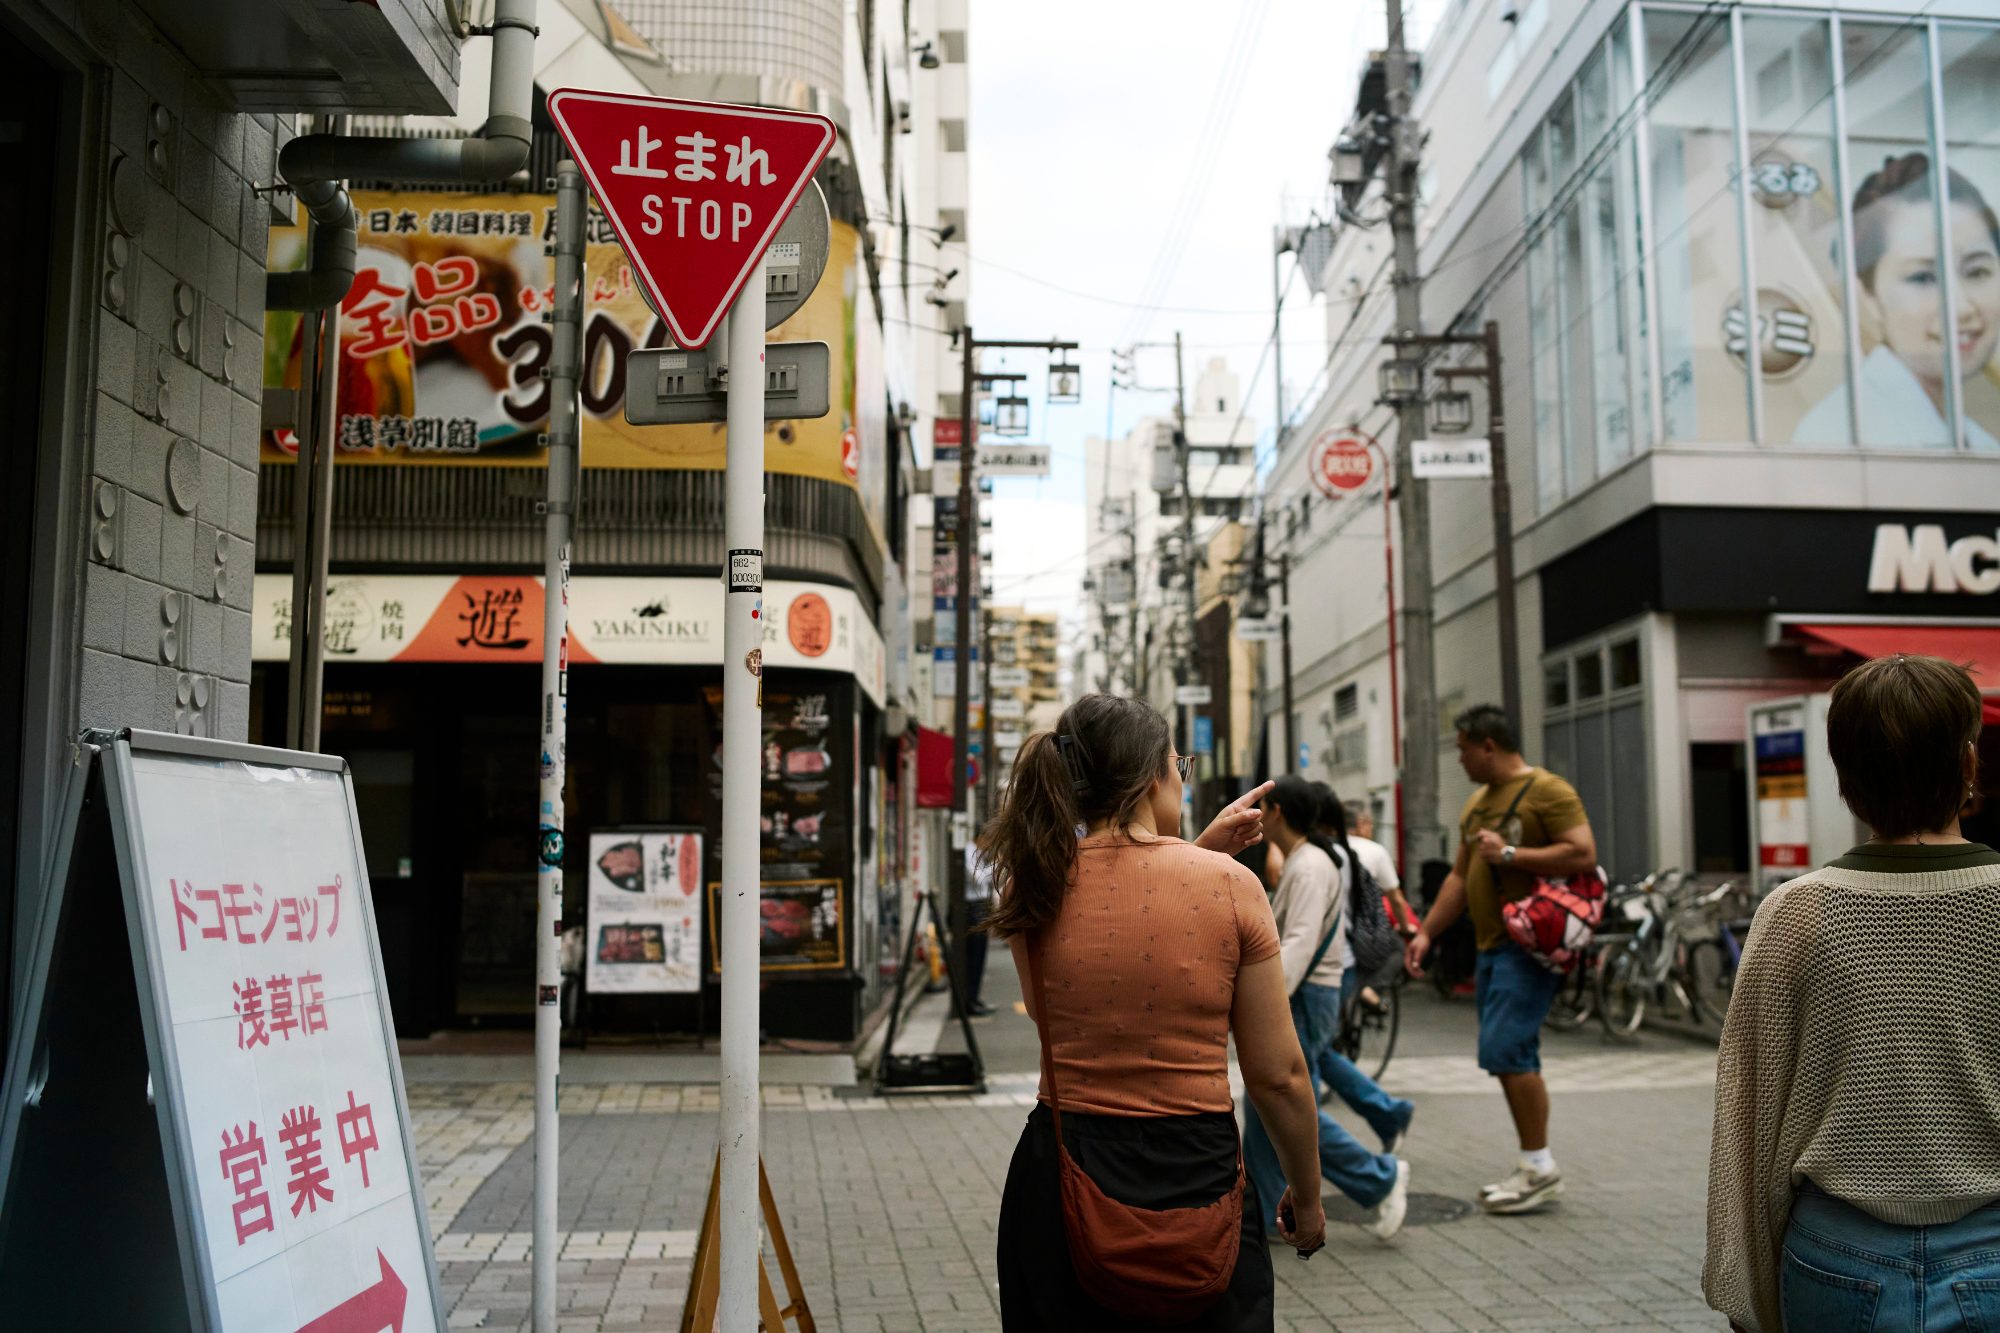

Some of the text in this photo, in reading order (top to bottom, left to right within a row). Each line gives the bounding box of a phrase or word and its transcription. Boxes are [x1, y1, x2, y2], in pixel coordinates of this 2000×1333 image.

[611, 125, 778, 187] 止まれ
[641, 194, 752, 243] STOP
[343, 257, 500, 357] 全品
[342, 415, 478, 449] 浅草別館
[1868, 523, 2000, 595] Mc
[456, 586, 532, 649] 遊
[592, 619, 709, 637] YAKINIKU
[170, 873, 342, 952] ドコモショップ
[233, 970, 329, 1051] 浅草店
[219, 1090, 379, 1247] 営業中
